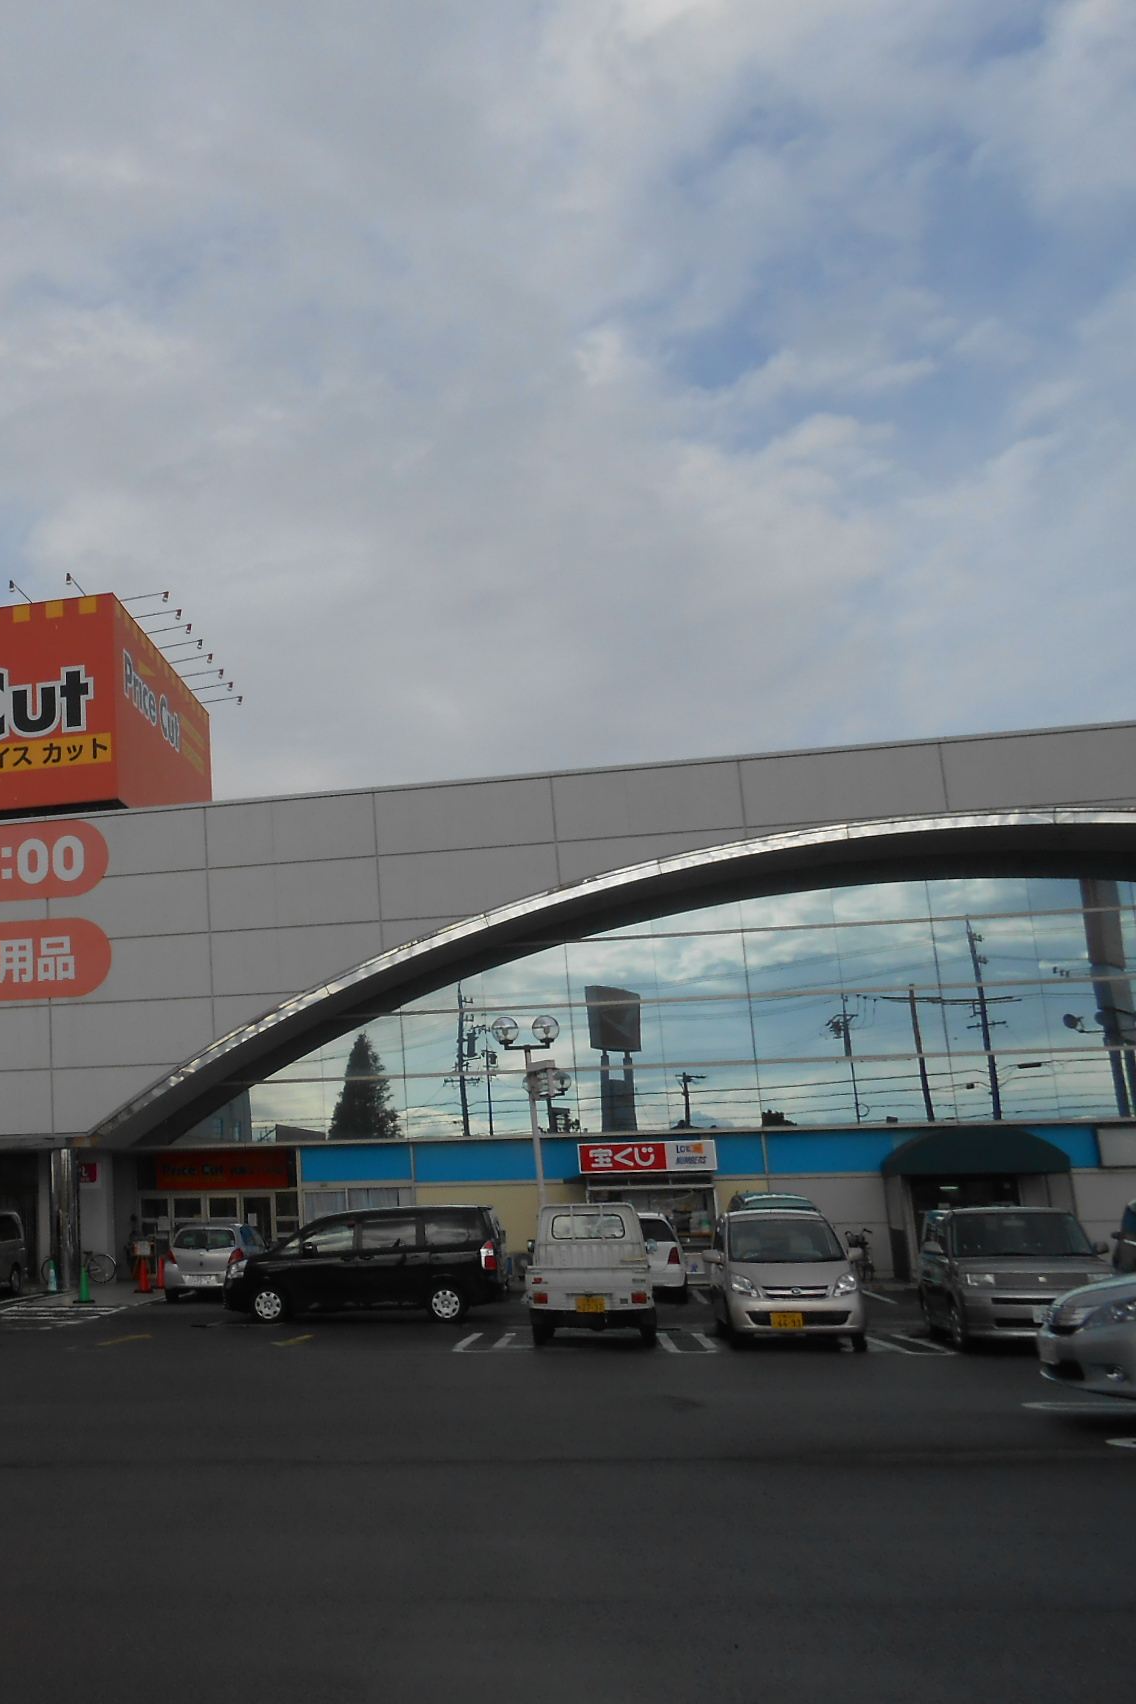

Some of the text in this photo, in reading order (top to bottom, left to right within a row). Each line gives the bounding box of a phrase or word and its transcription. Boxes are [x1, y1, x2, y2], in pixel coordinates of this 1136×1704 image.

[123, 648, 181, 752] Price Cut
[589, 1147, 655, 1167] 宝くじ
[162, 1164, 196, 1175] Price
